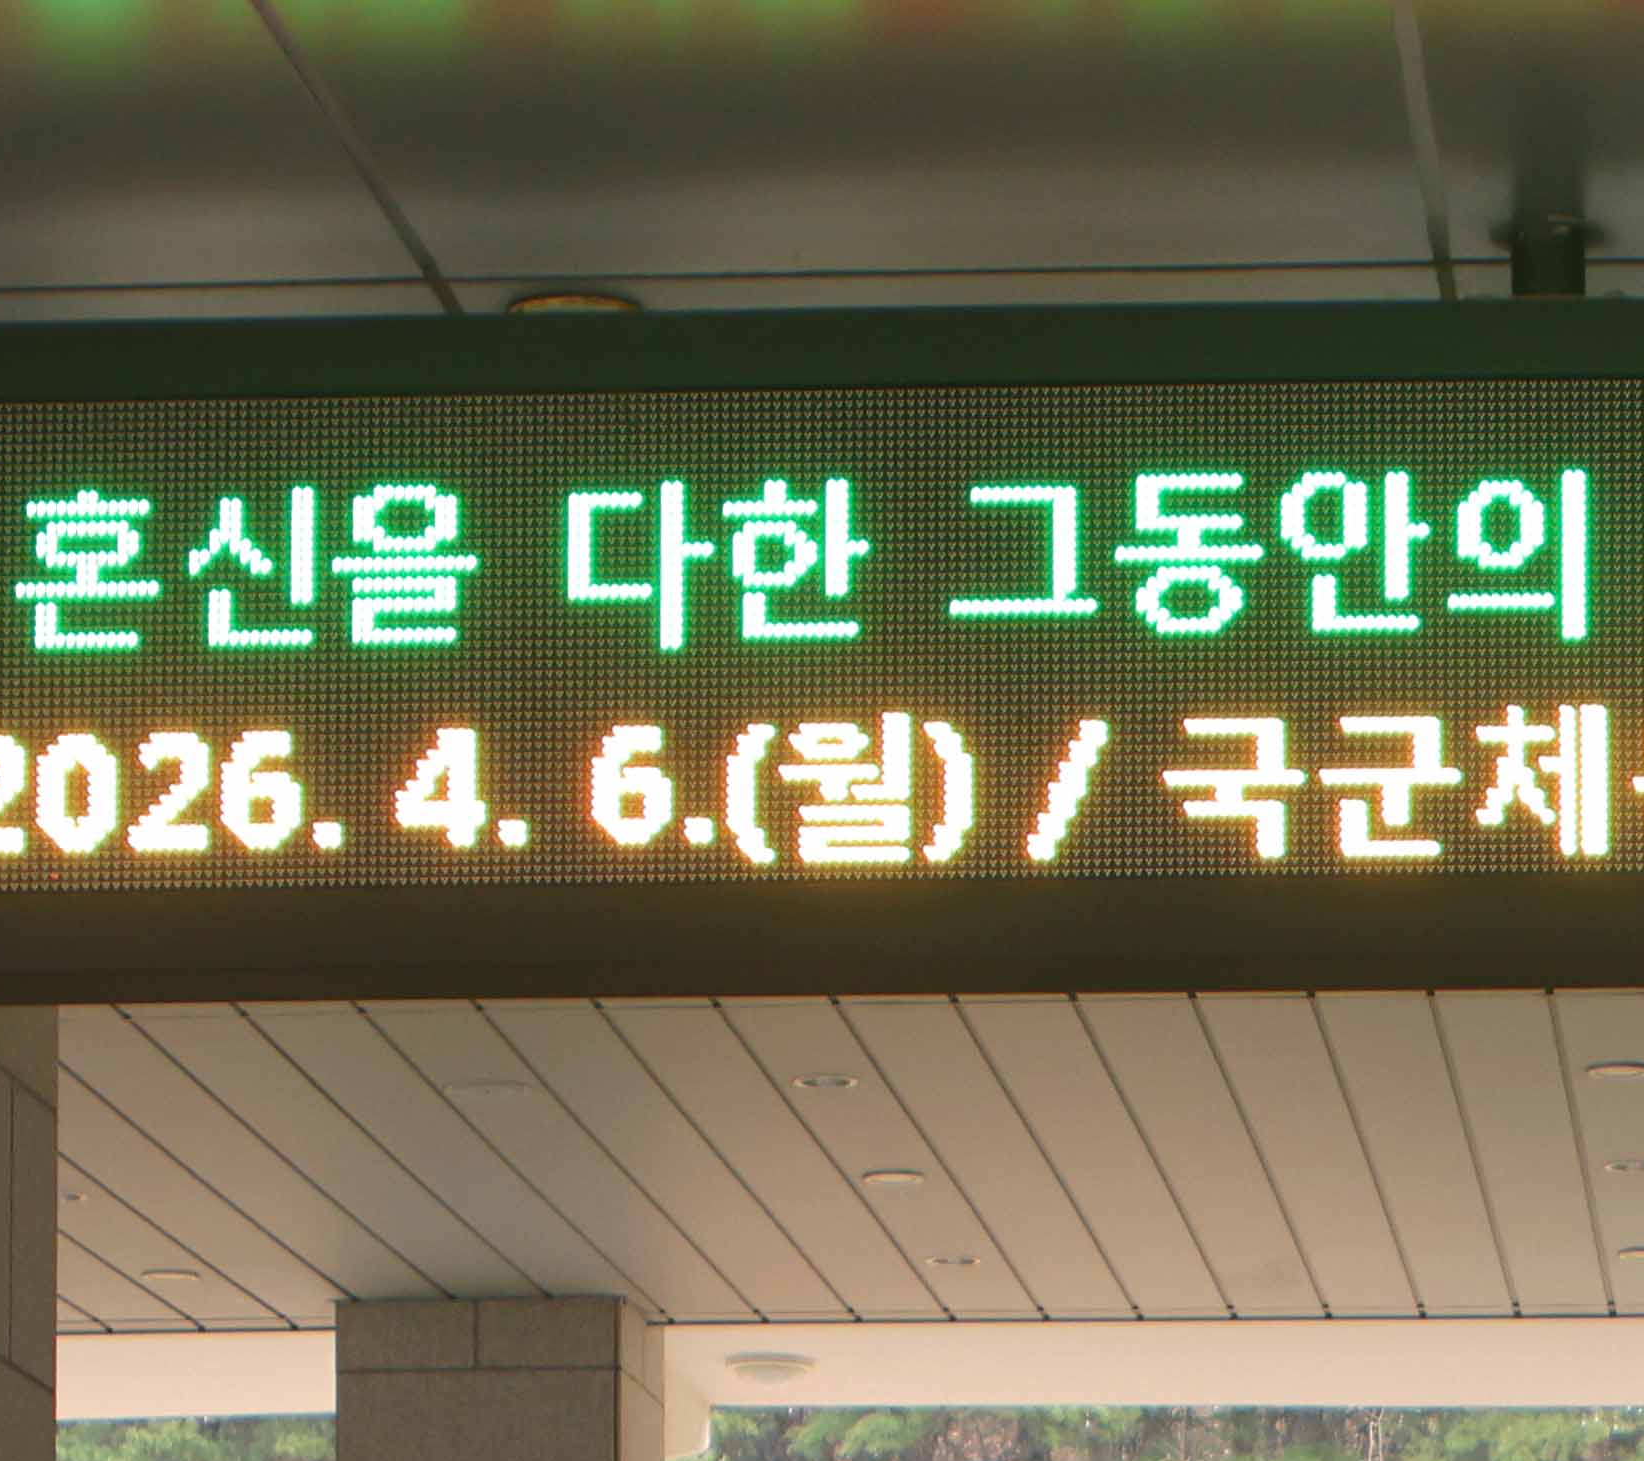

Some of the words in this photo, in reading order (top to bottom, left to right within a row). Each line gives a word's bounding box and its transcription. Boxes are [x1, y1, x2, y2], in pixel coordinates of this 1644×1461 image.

[14, 483, 479, 658] 혼신을
[566, 477, 871, 652] 다한
[948, 468, 1588, 642] 그동안의
[394, 726, 528, 849] 4.
[589, 710, 974, 865] 6.(월)
